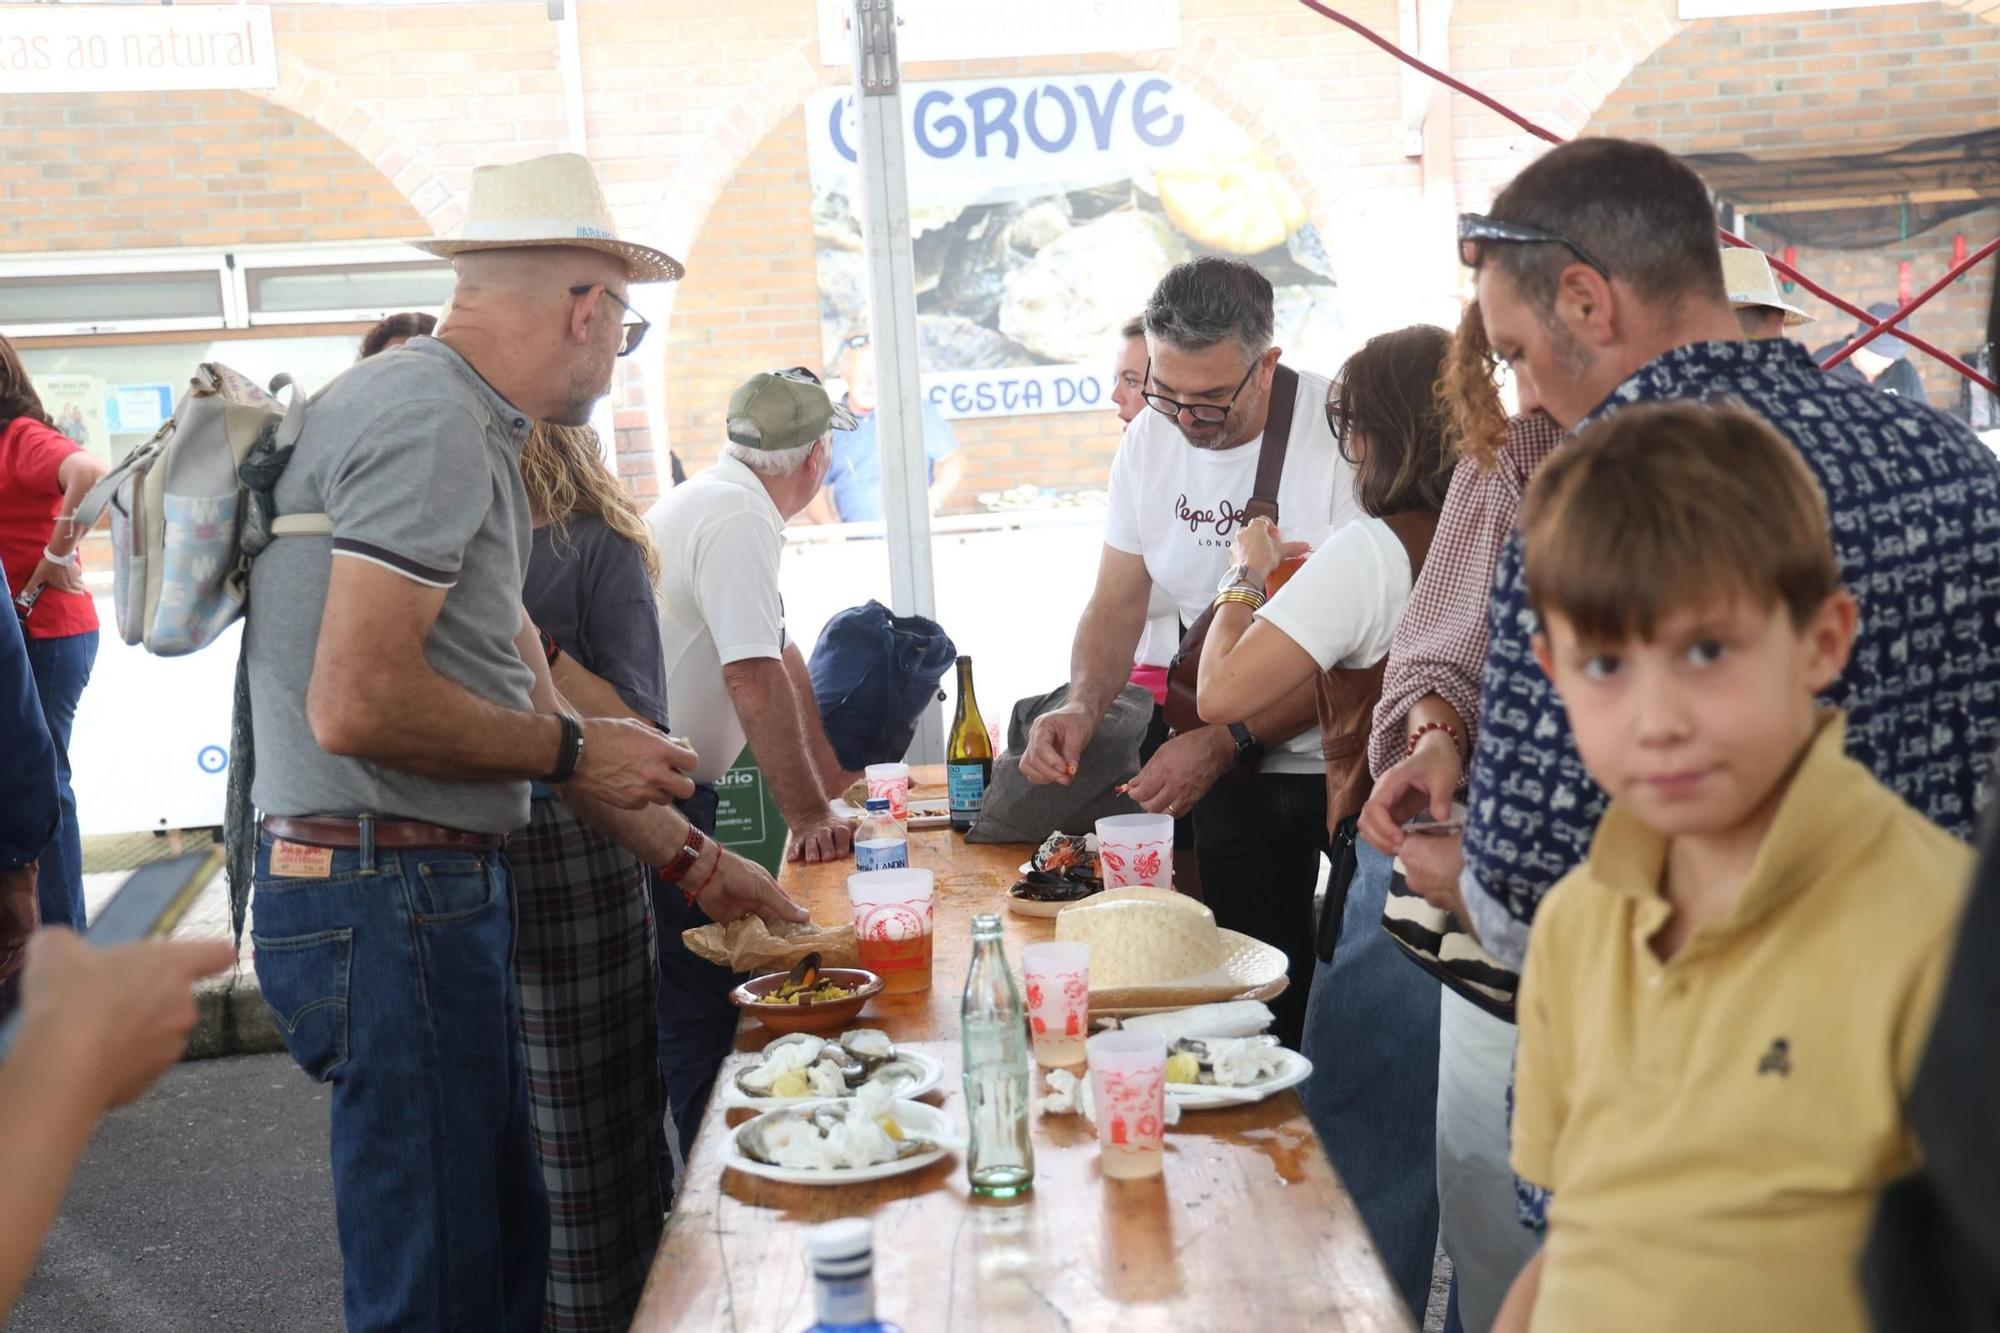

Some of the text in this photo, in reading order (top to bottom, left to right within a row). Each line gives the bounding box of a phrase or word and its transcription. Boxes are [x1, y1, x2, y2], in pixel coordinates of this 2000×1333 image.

[66, 34, 108, 69] ao
[121, 20, 256, 68] natural
[913, 78, 1185, 159] GROVE
[929, 376, 1101, 413] FESTA DO
[1175, 493, 1216, 533] Pepe
